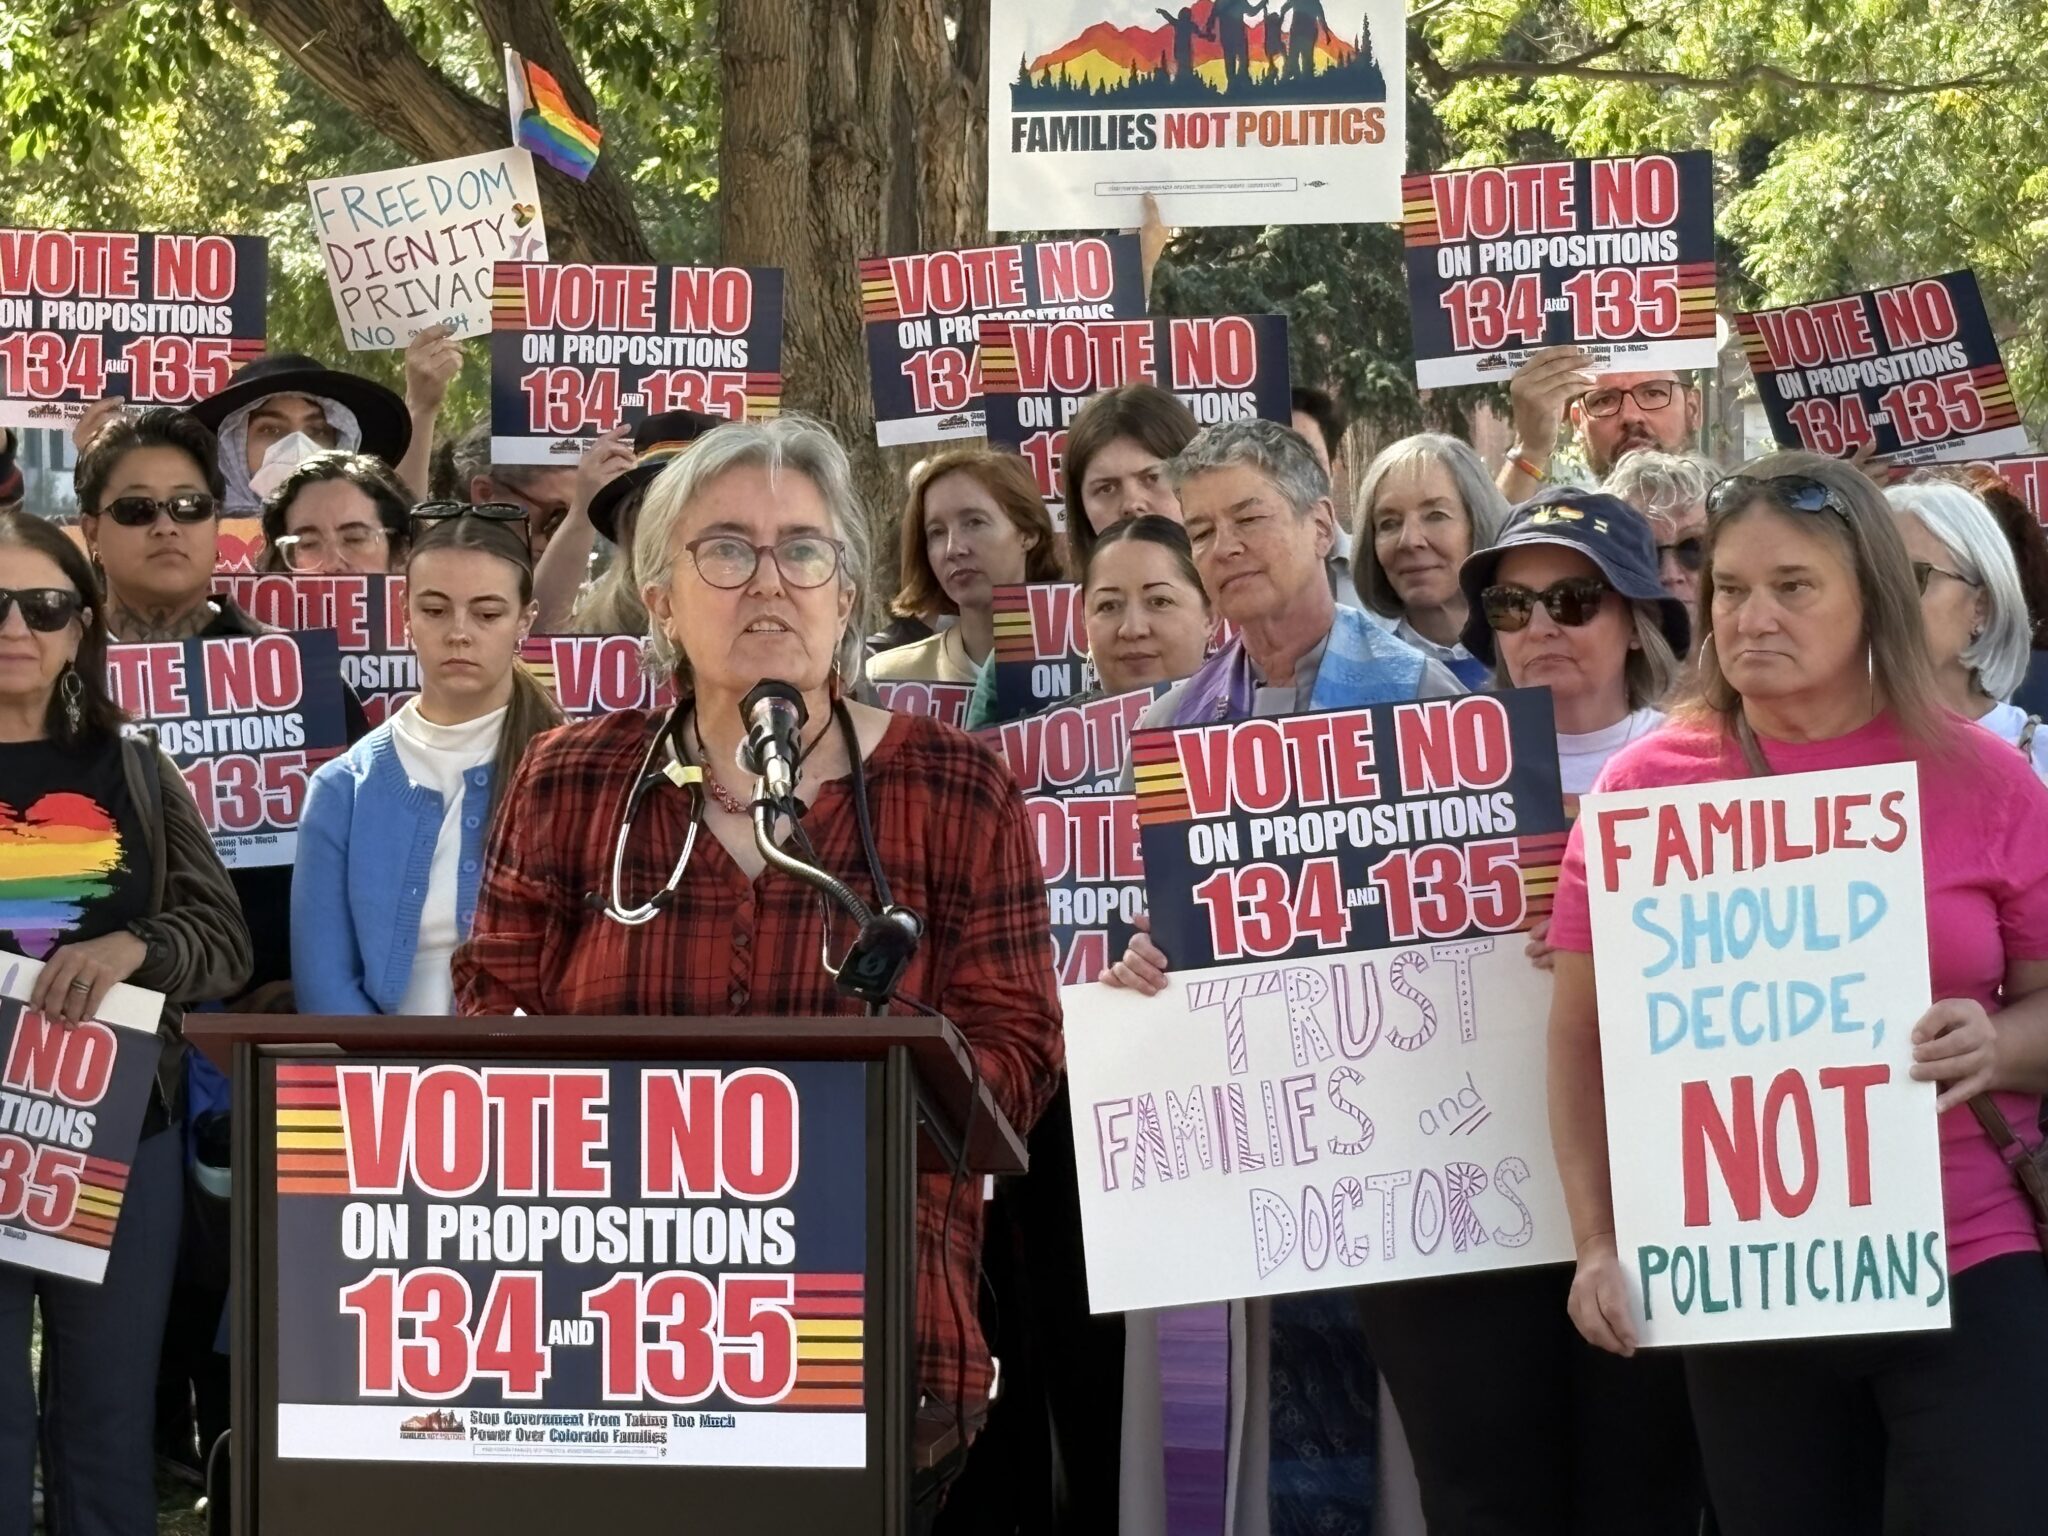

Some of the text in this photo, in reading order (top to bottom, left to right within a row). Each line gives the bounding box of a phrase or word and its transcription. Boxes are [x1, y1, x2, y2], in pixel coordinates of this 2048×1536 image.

[1011, 107, 1387, 153] FAMILIES NOT POLITICS
[313, 162, 517, 235] FREEDOM
[1430, 155, 1679, 243] VOTE NO
[0, 229, 236, 303] VOTE NO
[327, 213, 506, 284] DIGNITY
[888, 238, 1114, 318] VOTE NO
[1437, 230, 1679, 279] ON PROPOSITIONS
[0, 299, 233, 336] ON PROPOSITIONS
[340, 267, 493, 323] PRIVAC
[522, 264, 752, 336] VOTE NO
[1440, 265, 1681, 351] 134 AND 135
[1753, 279, 1958, 370] VOTE NO
[0, 331, 234, 403] 134 AND 135
[351, 326, 396, 349] NO
[522, 334, 749, 368] ON PROPOSITIONS
[898, 321, 933, 349] ON
[1009, 320, 1157, 393] VOTE
[1169, 315, 1257, 390] NO
[1776, 341, 1969, 400] ON PROPOSITIONS
[521, 366, 623, 434] 134
[1017, 396, 1053, 428] ON
[1786, 370, 1986, 458] 134 AND 135
[106, 642, 190, 720] TE
[203, 634, 303, 715] NO
[551, 635, 675, 712] VO
[1031, 664, 1071, 698] ON
[120, 713, 306, 756] OSITIONS
[1174, 695, 1513, 819] VOTE NO
[181, 750, 307, 832] 135
[1188, 791, 1517, 865] ON PROPOSITIONS
[1025, 795, 1145, 884] OTE
[1597, 790, 1907, 892] FAMILIES
[1193, 857, 1353, 961] 134
[1347, 884, 1380, 908] AND
[1367, 836, 1527, 942] 135
[1632, 880, 1889, 978] SHOULD
[1186, 938, 1494, 1075] TRUST
[1647, 972, 1885, 1054] DECIDE,
[2, 1004, 118, 1106] NO
[336, 1064, 800, 1201] VOTE NO
[1093, 1066, 1483, 1192] FAMILIES and
[1680, 1064, 1890, 1227] NOT
[0, 1133, 87, 1232] 35
[1250, 1156, 1534, 1280] DOCTORS
[341, 1202, 796, 1264] ON PROPOSITIONS
[1637, 1230, 1945, 1321] POLITICIANS
[340, 1266, 799, 1404] 134 AND 135
[470, 1410, 500, 1426] Stop
[504, 1411, 584, 1427] Government
[588, 1412, 620, 1427] From
[625, 1412, 668, 1428] Taking
[699, 1413, 736, 1428] Much
[470, 1427, 668, 1444] Power Over Colorado Families
